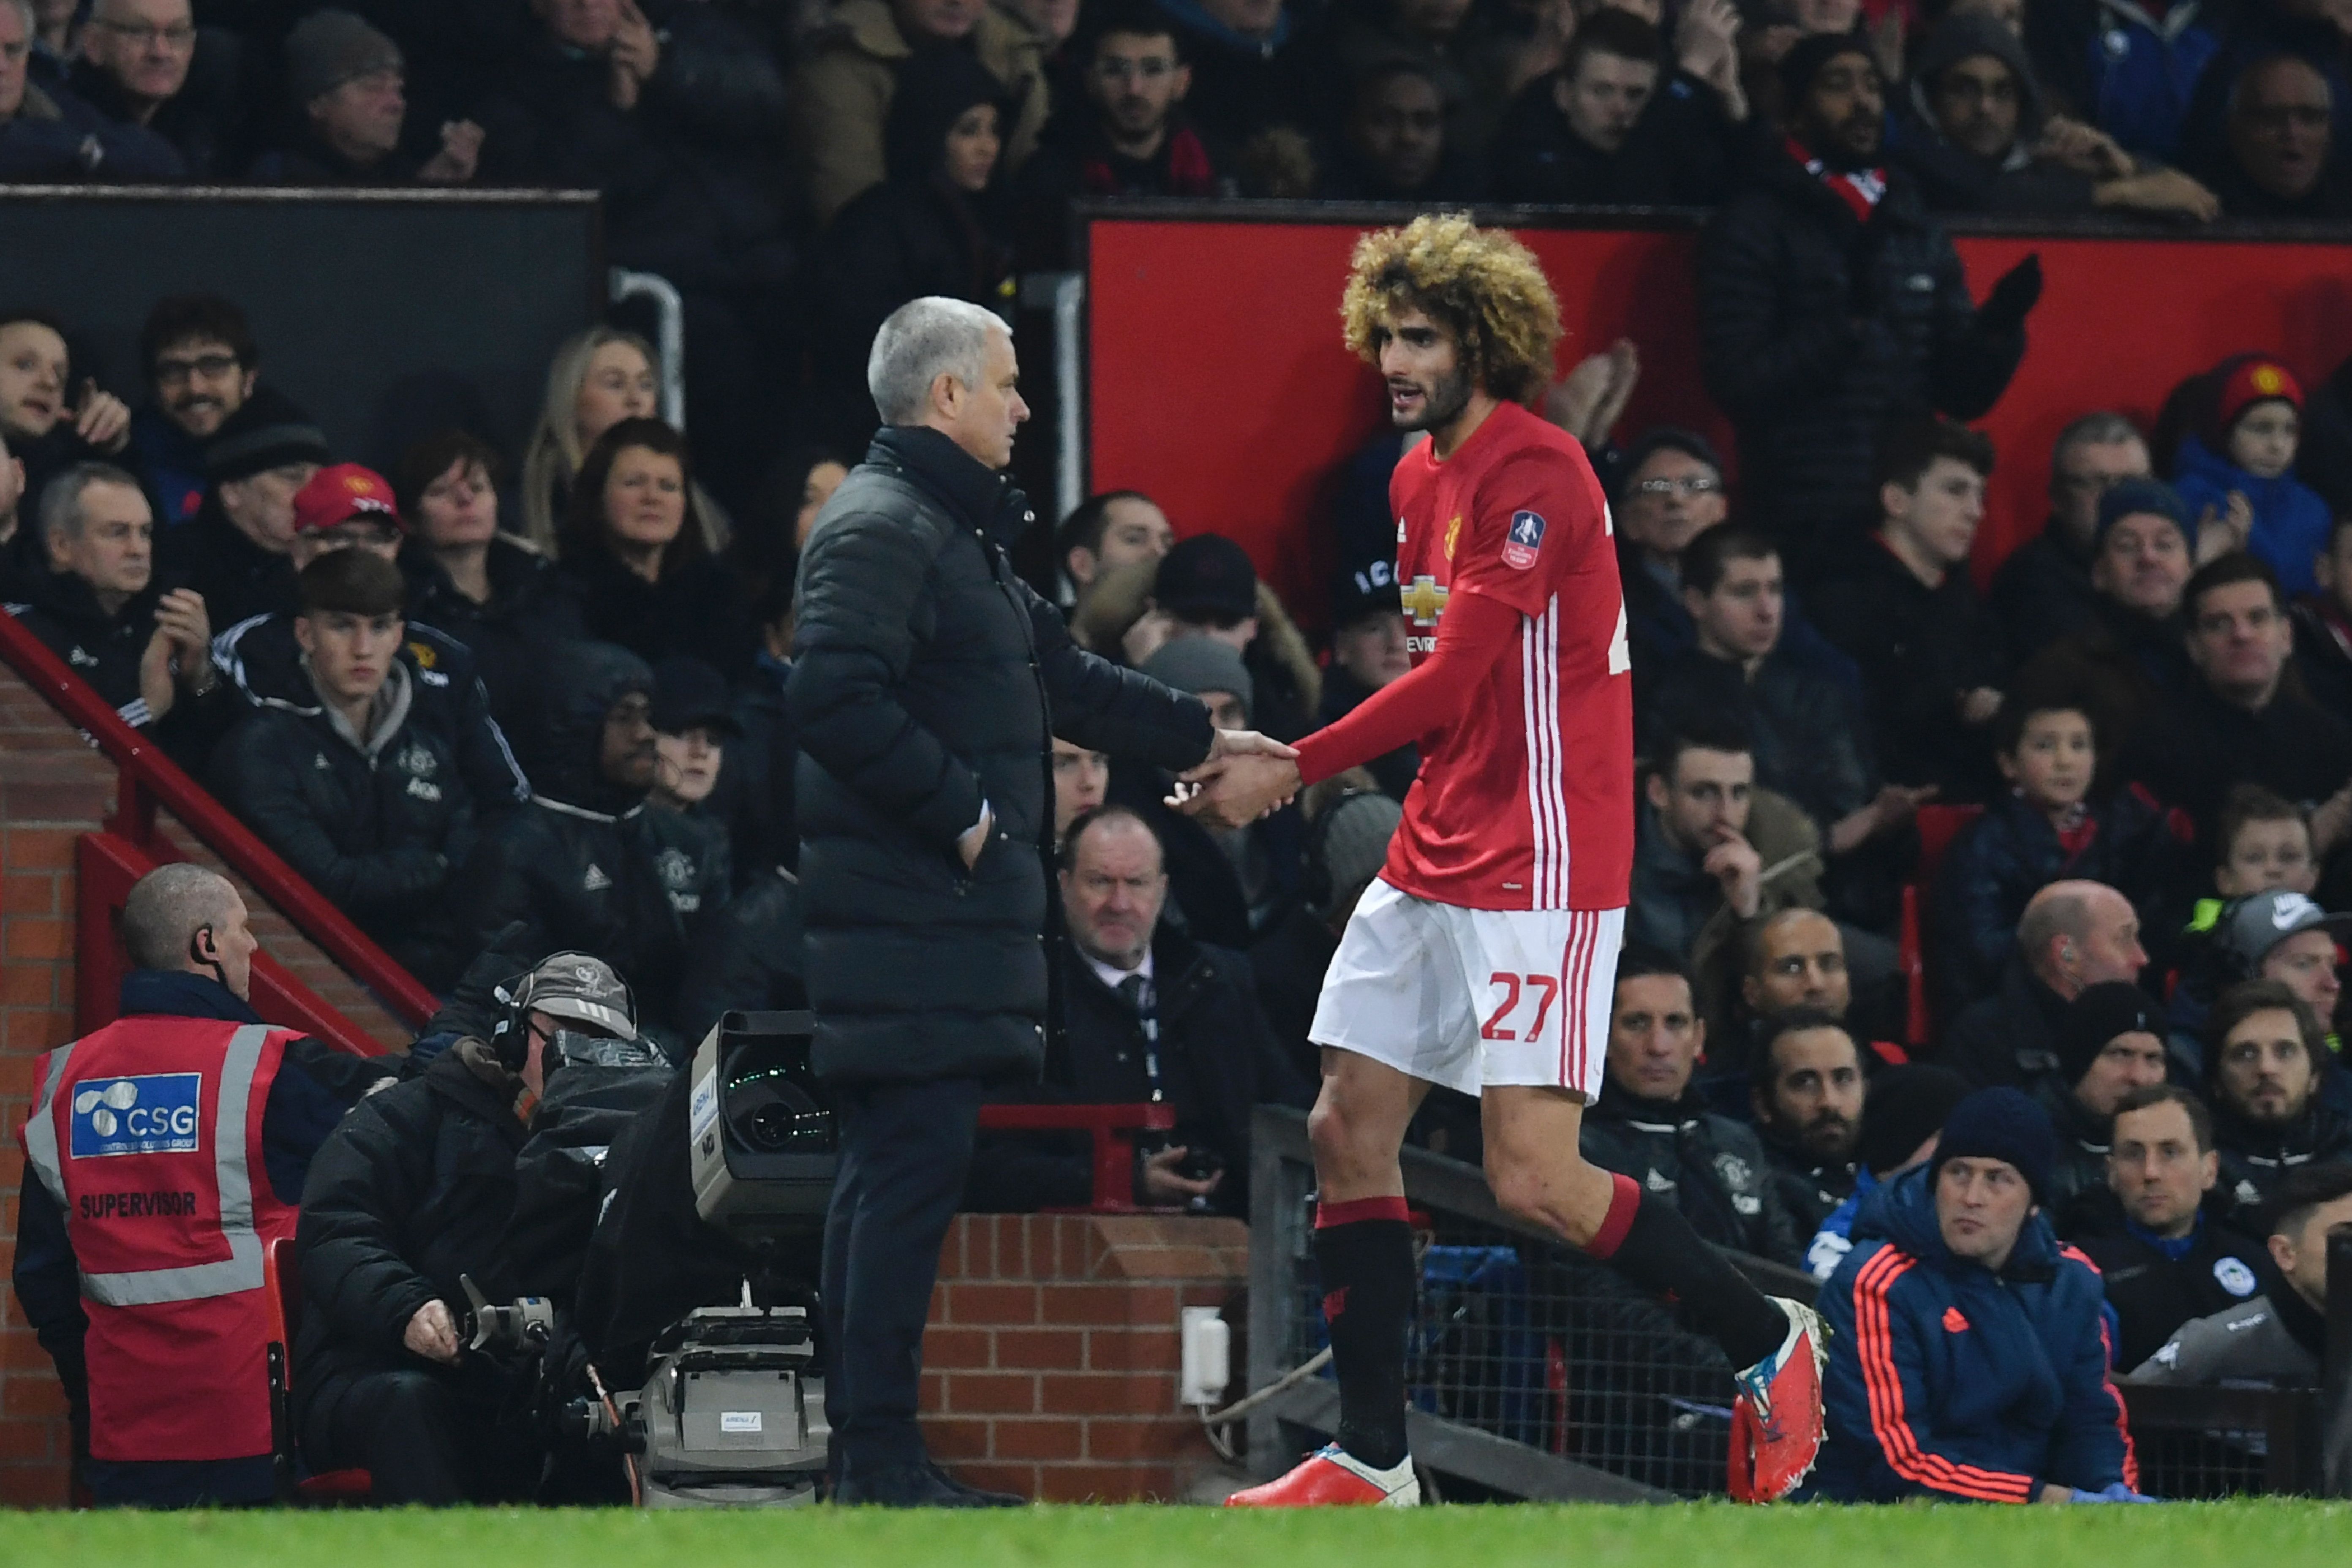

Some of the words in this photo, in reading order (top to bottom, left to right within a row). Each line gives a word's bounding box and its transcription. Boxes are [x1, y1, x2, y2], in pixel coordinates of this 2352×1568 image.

[1481, 972, 1558, 1043] 27
[128, 1105, 193, 1136] CSG
[80, 1192, 196, 1219] SUPERVISOR
